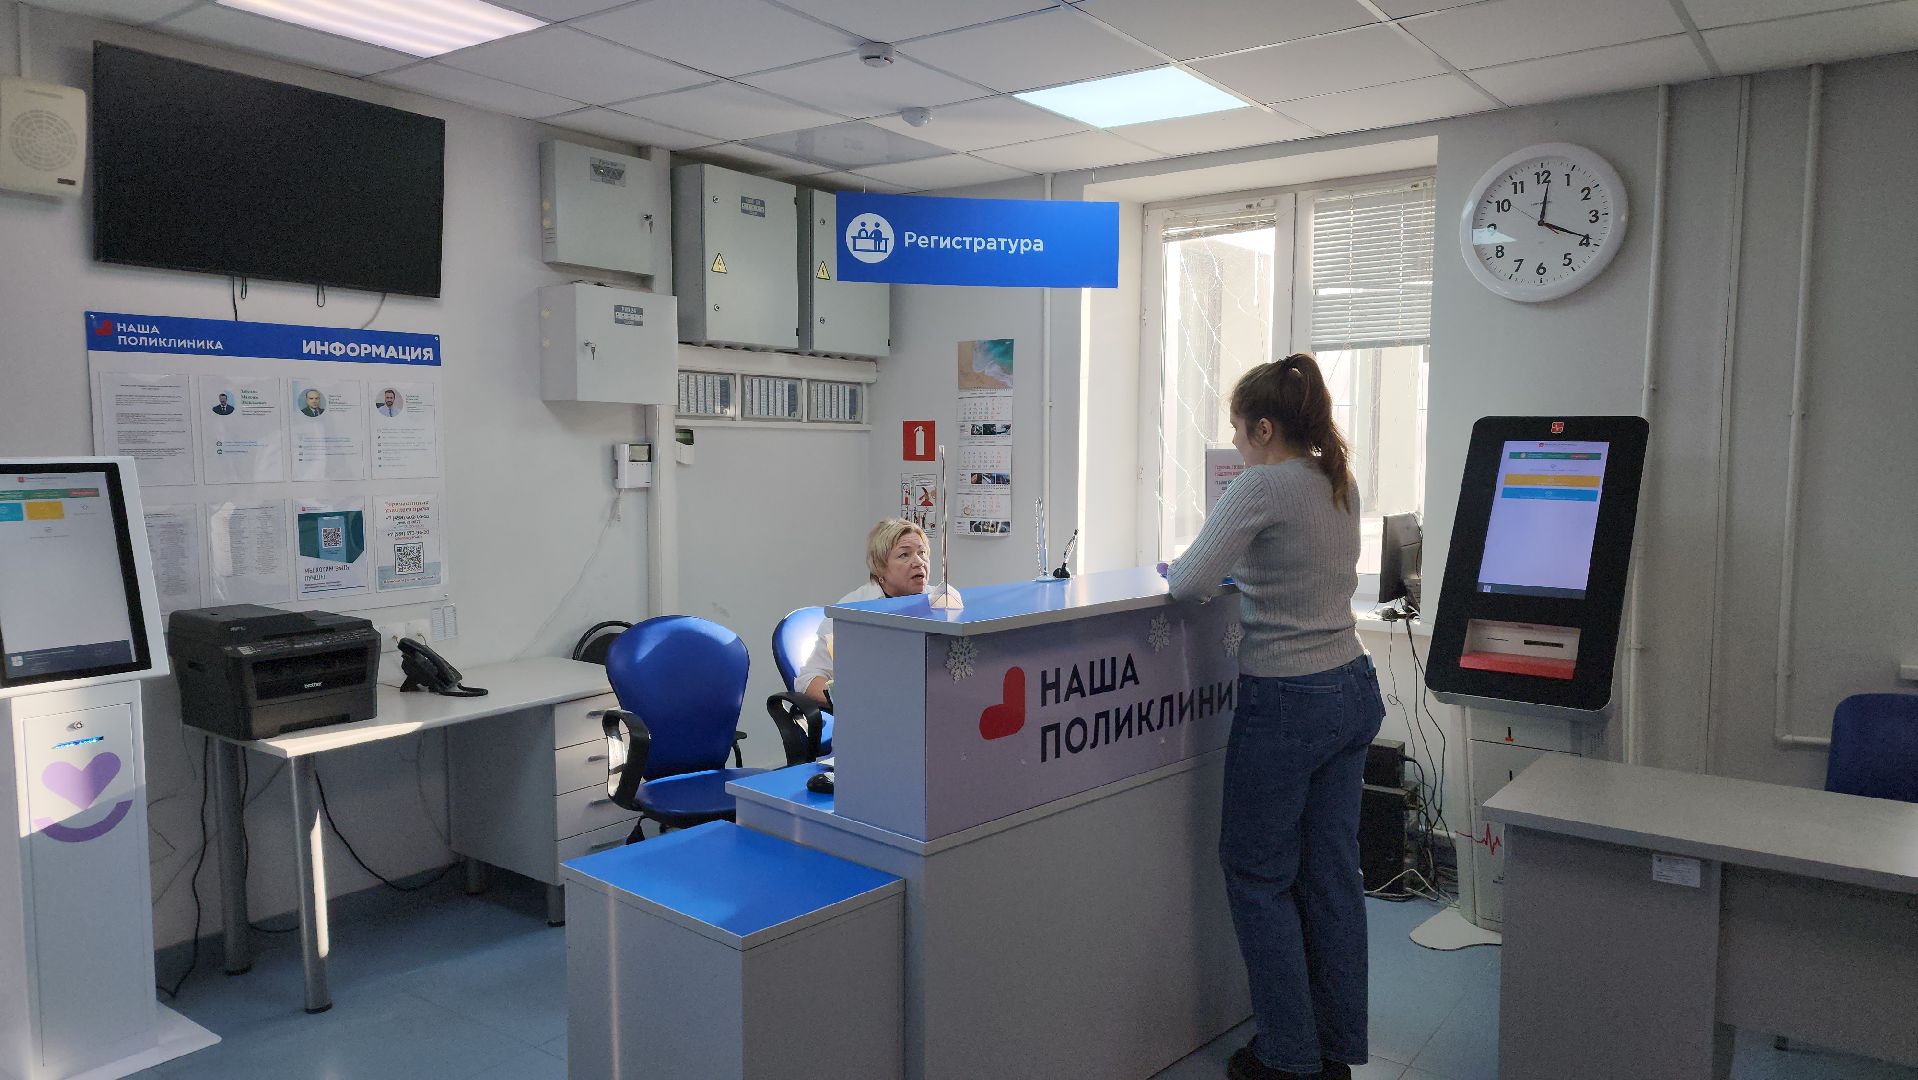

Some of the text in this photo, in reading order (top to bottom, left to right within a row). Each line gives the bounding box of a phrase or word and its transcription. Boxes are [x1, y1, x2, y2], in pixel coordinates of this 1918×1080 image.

[1511, 173, 1571, 195] 11 1
[1534, 170, 1552, 185] 12
[1495, 186, 1592, 213] 10 2
[1588, 209, 1600, 224] 3
[903, 231, 1045, 255] Регистратура
[1495, 234, 1590, 258] 8 4
[1513, 253, 1573, 276] 7 6 5
[116, 322, 160, 335] НАША
[117, 335, 224, 350] ПОЛИКЛИНИКА
[302, 339, 434, 362] ИНФОРМАЦИЯ
[1040, 653, 1140, 707] НАША
[1040, 679, 1240, 763] ПОЛИКЛИНИ
